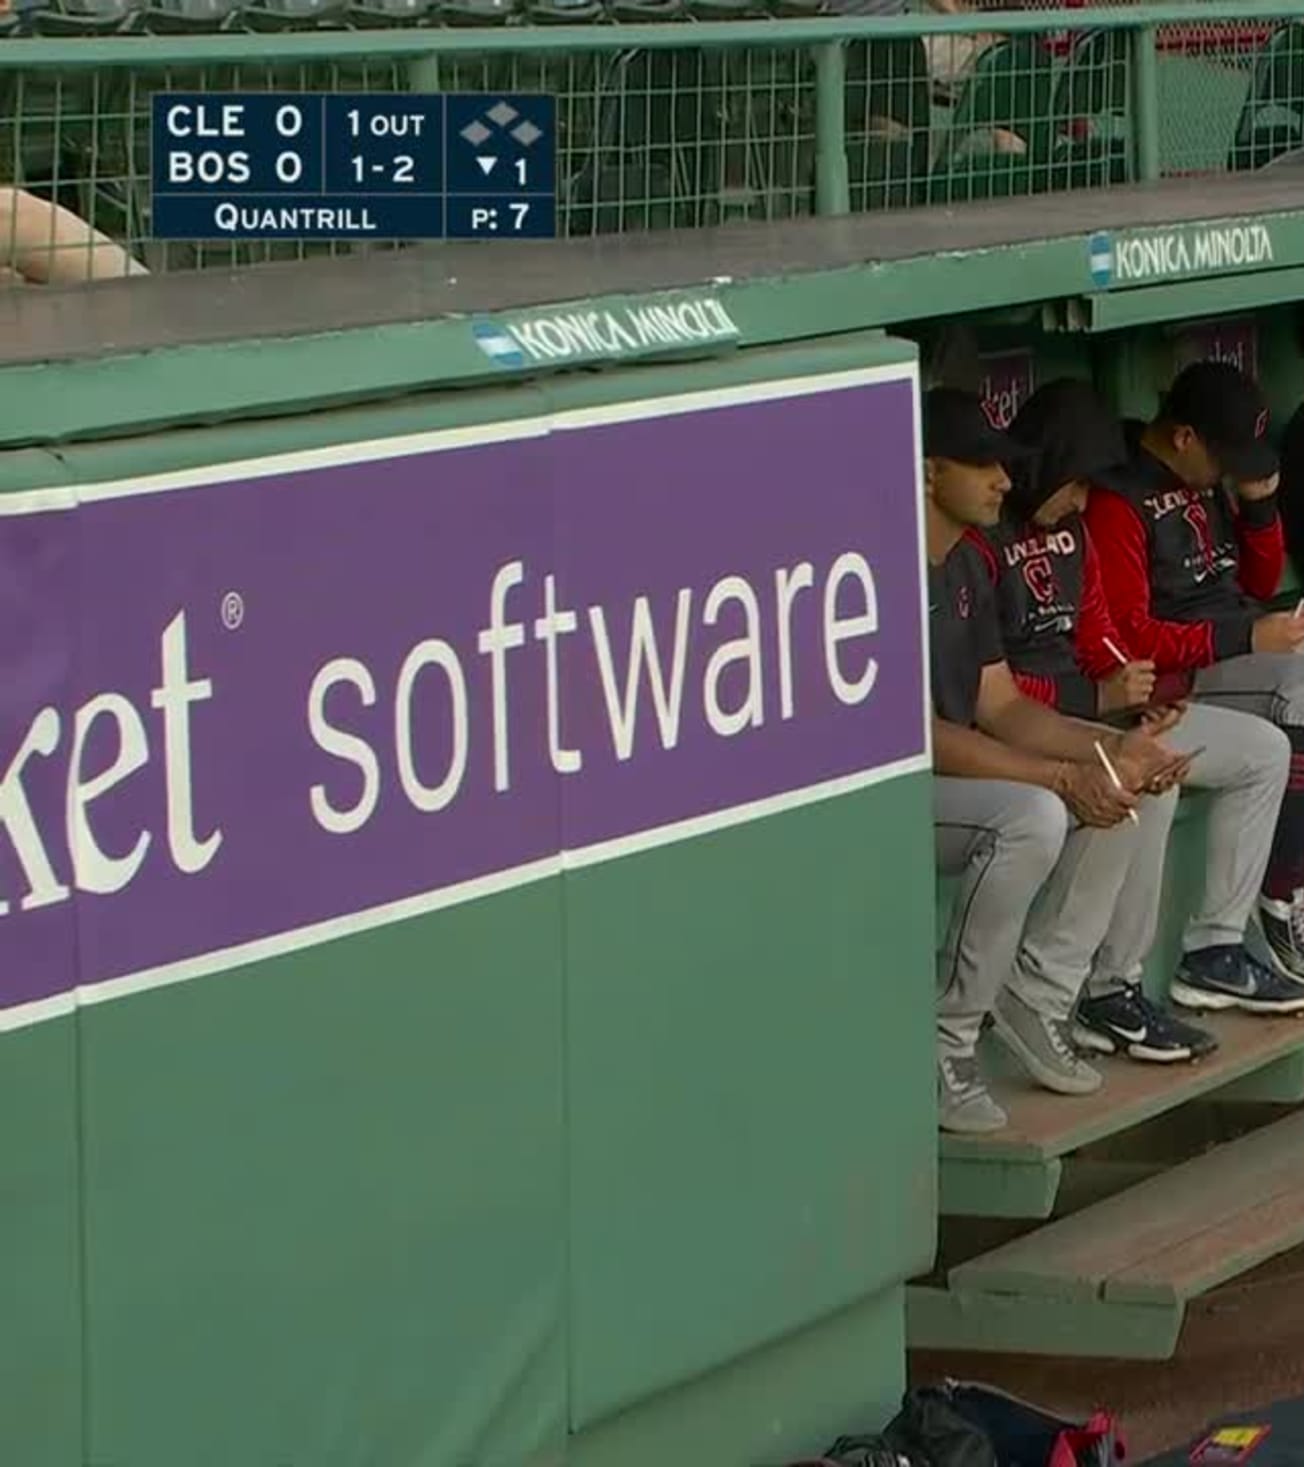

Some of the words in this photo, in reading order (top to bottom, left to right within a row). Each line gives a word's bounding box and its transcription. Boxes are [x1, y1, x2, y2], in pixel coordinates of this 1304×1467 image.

[1115, 233, 1191, 279] KONICA
[1193, 224, 1274, 270] MINOLTA
[507, 311, 638, 359] KONICA
[306, 549, 881, 835] software
